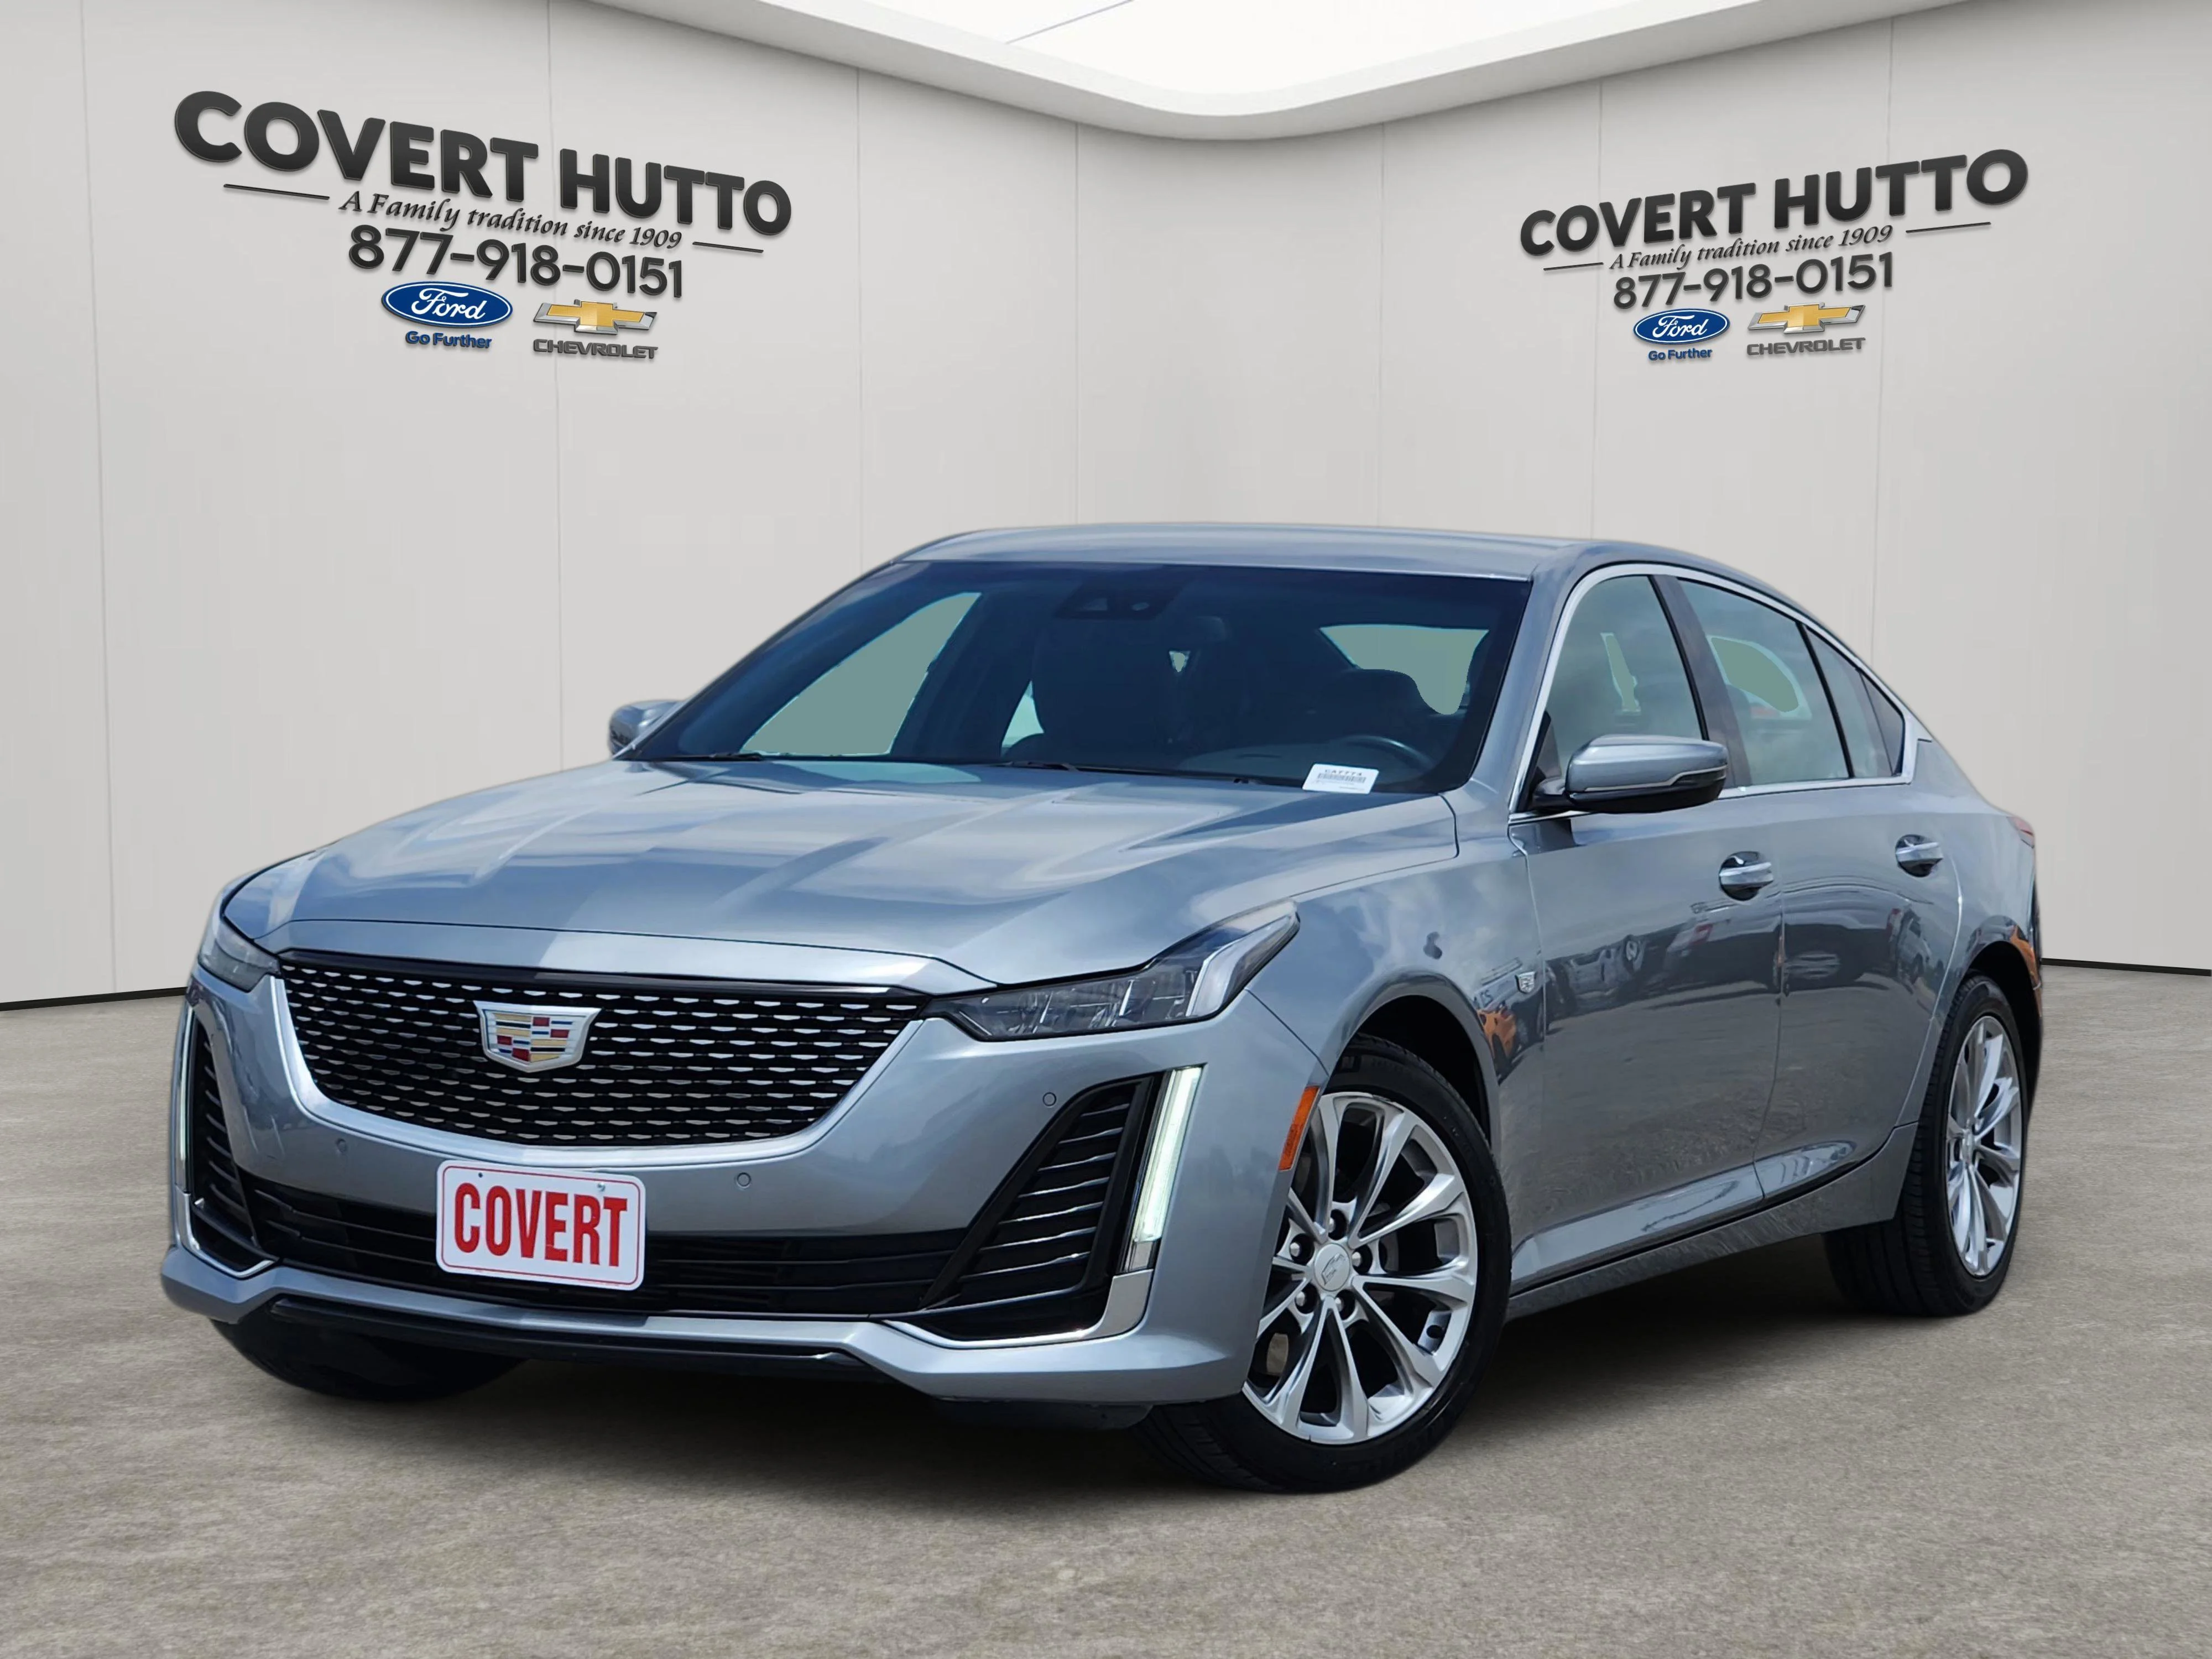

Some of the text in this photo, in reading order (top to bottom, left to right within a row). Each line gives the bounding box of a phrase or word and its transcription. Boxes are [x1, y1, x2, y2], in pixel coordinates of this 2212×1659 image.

[174, 90, 792, 237] COVERT HUTTO
[338, 190, 682, 249] A Family tradition since 1909
[1520, 149, 2029, 258] COVERT HUTTO
[348, 224, 682, 299] 877-918-0151
[1609, 225, 1893, 271] A Family tradition since 1909
[1613, 251, 1893, 310] 877-918-0151
[411, 288, 487, 321] Ford
[1652, 314, 1709, 338] Ford
[405, 331, 492, 349] Go Further
[533, 338, 659, 359] CHEVROLET
[1648, 347, 1713, 361] Go Further
[1746, 337, 1866, 356] CHEVROLET
[454, 1182, 628, 1267] COVERT
